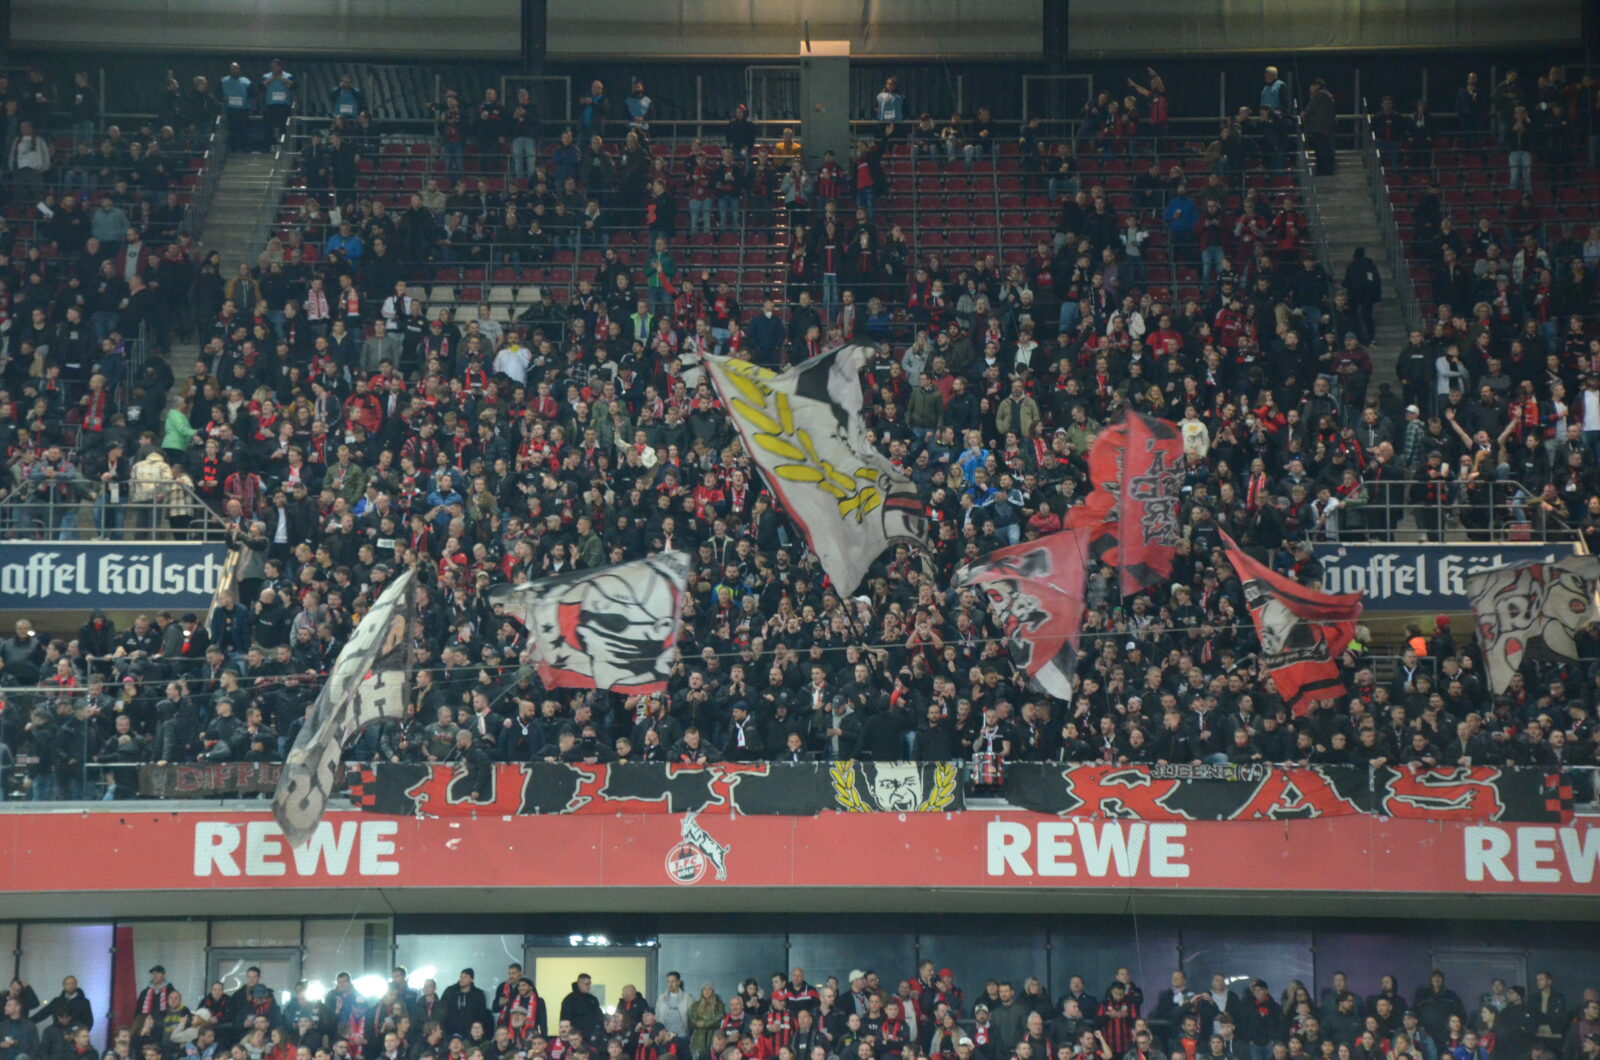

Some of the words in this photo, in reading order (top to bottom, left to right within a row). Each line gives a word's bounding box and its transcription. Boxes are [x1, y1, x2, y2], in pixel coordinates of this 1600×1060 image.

[1319, 553, 1432, 599] Gaffel
[193, 821, 400, 877] REWE
[986, 821, 1191, 878] REWE
